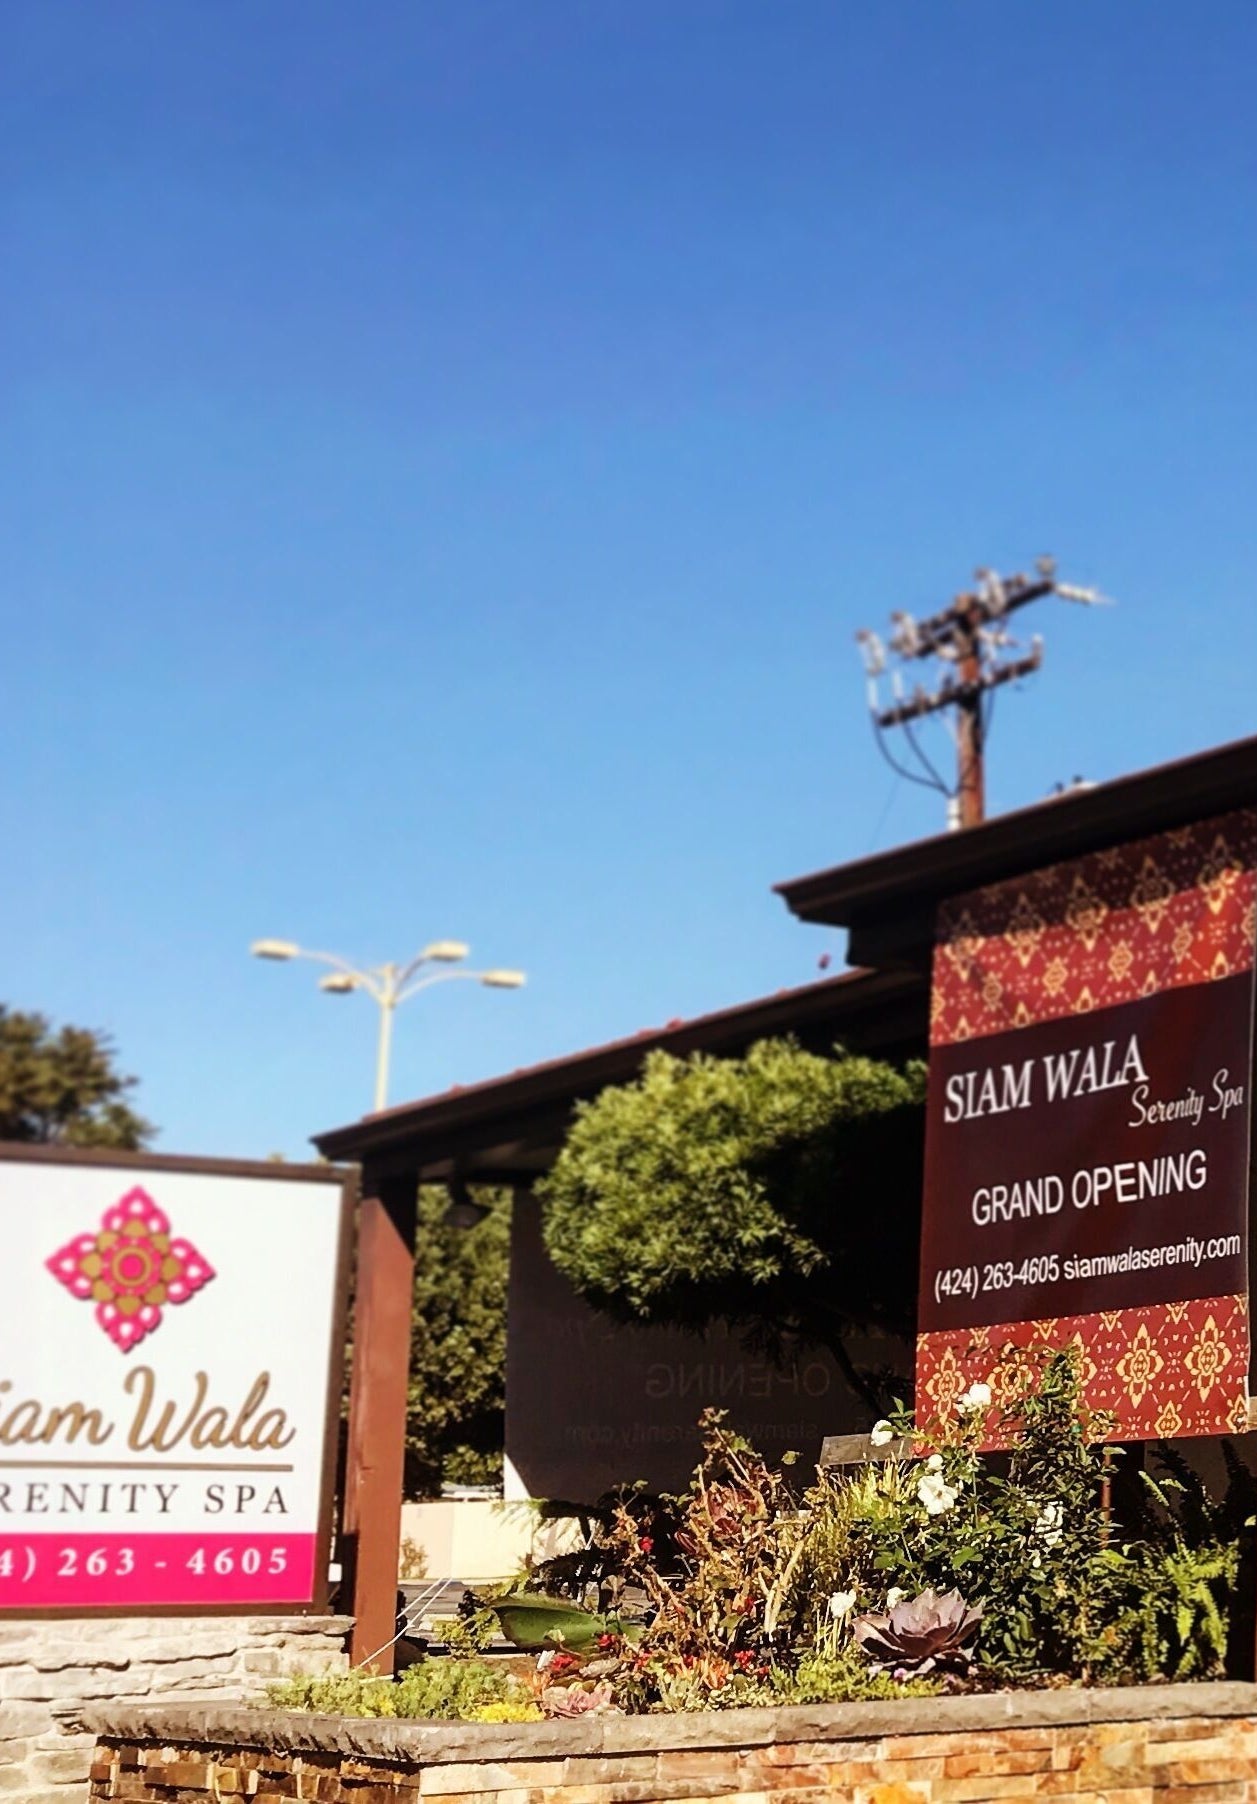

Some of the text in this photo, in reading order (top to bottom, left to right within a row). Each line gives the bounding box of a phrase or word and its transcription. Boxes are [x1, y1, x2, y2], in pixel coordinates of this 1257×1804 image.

[943, 1034, 1149, 1123] SIAM WALA
[1128, 1068, 1244, 1127] Serenity Spa
[971, 1149, 1207, 1226] GRAND OPENING
[934, 1234, 1241, 1304] (424) 263-4605 siamwalaserenity.com
[0, 1365, 296, 1453] am Wala
[203, 1485, 290, 1515] SPA
[56, 1547, 136, 1577] 263
[185, 1547, 288, 1577] 4605
